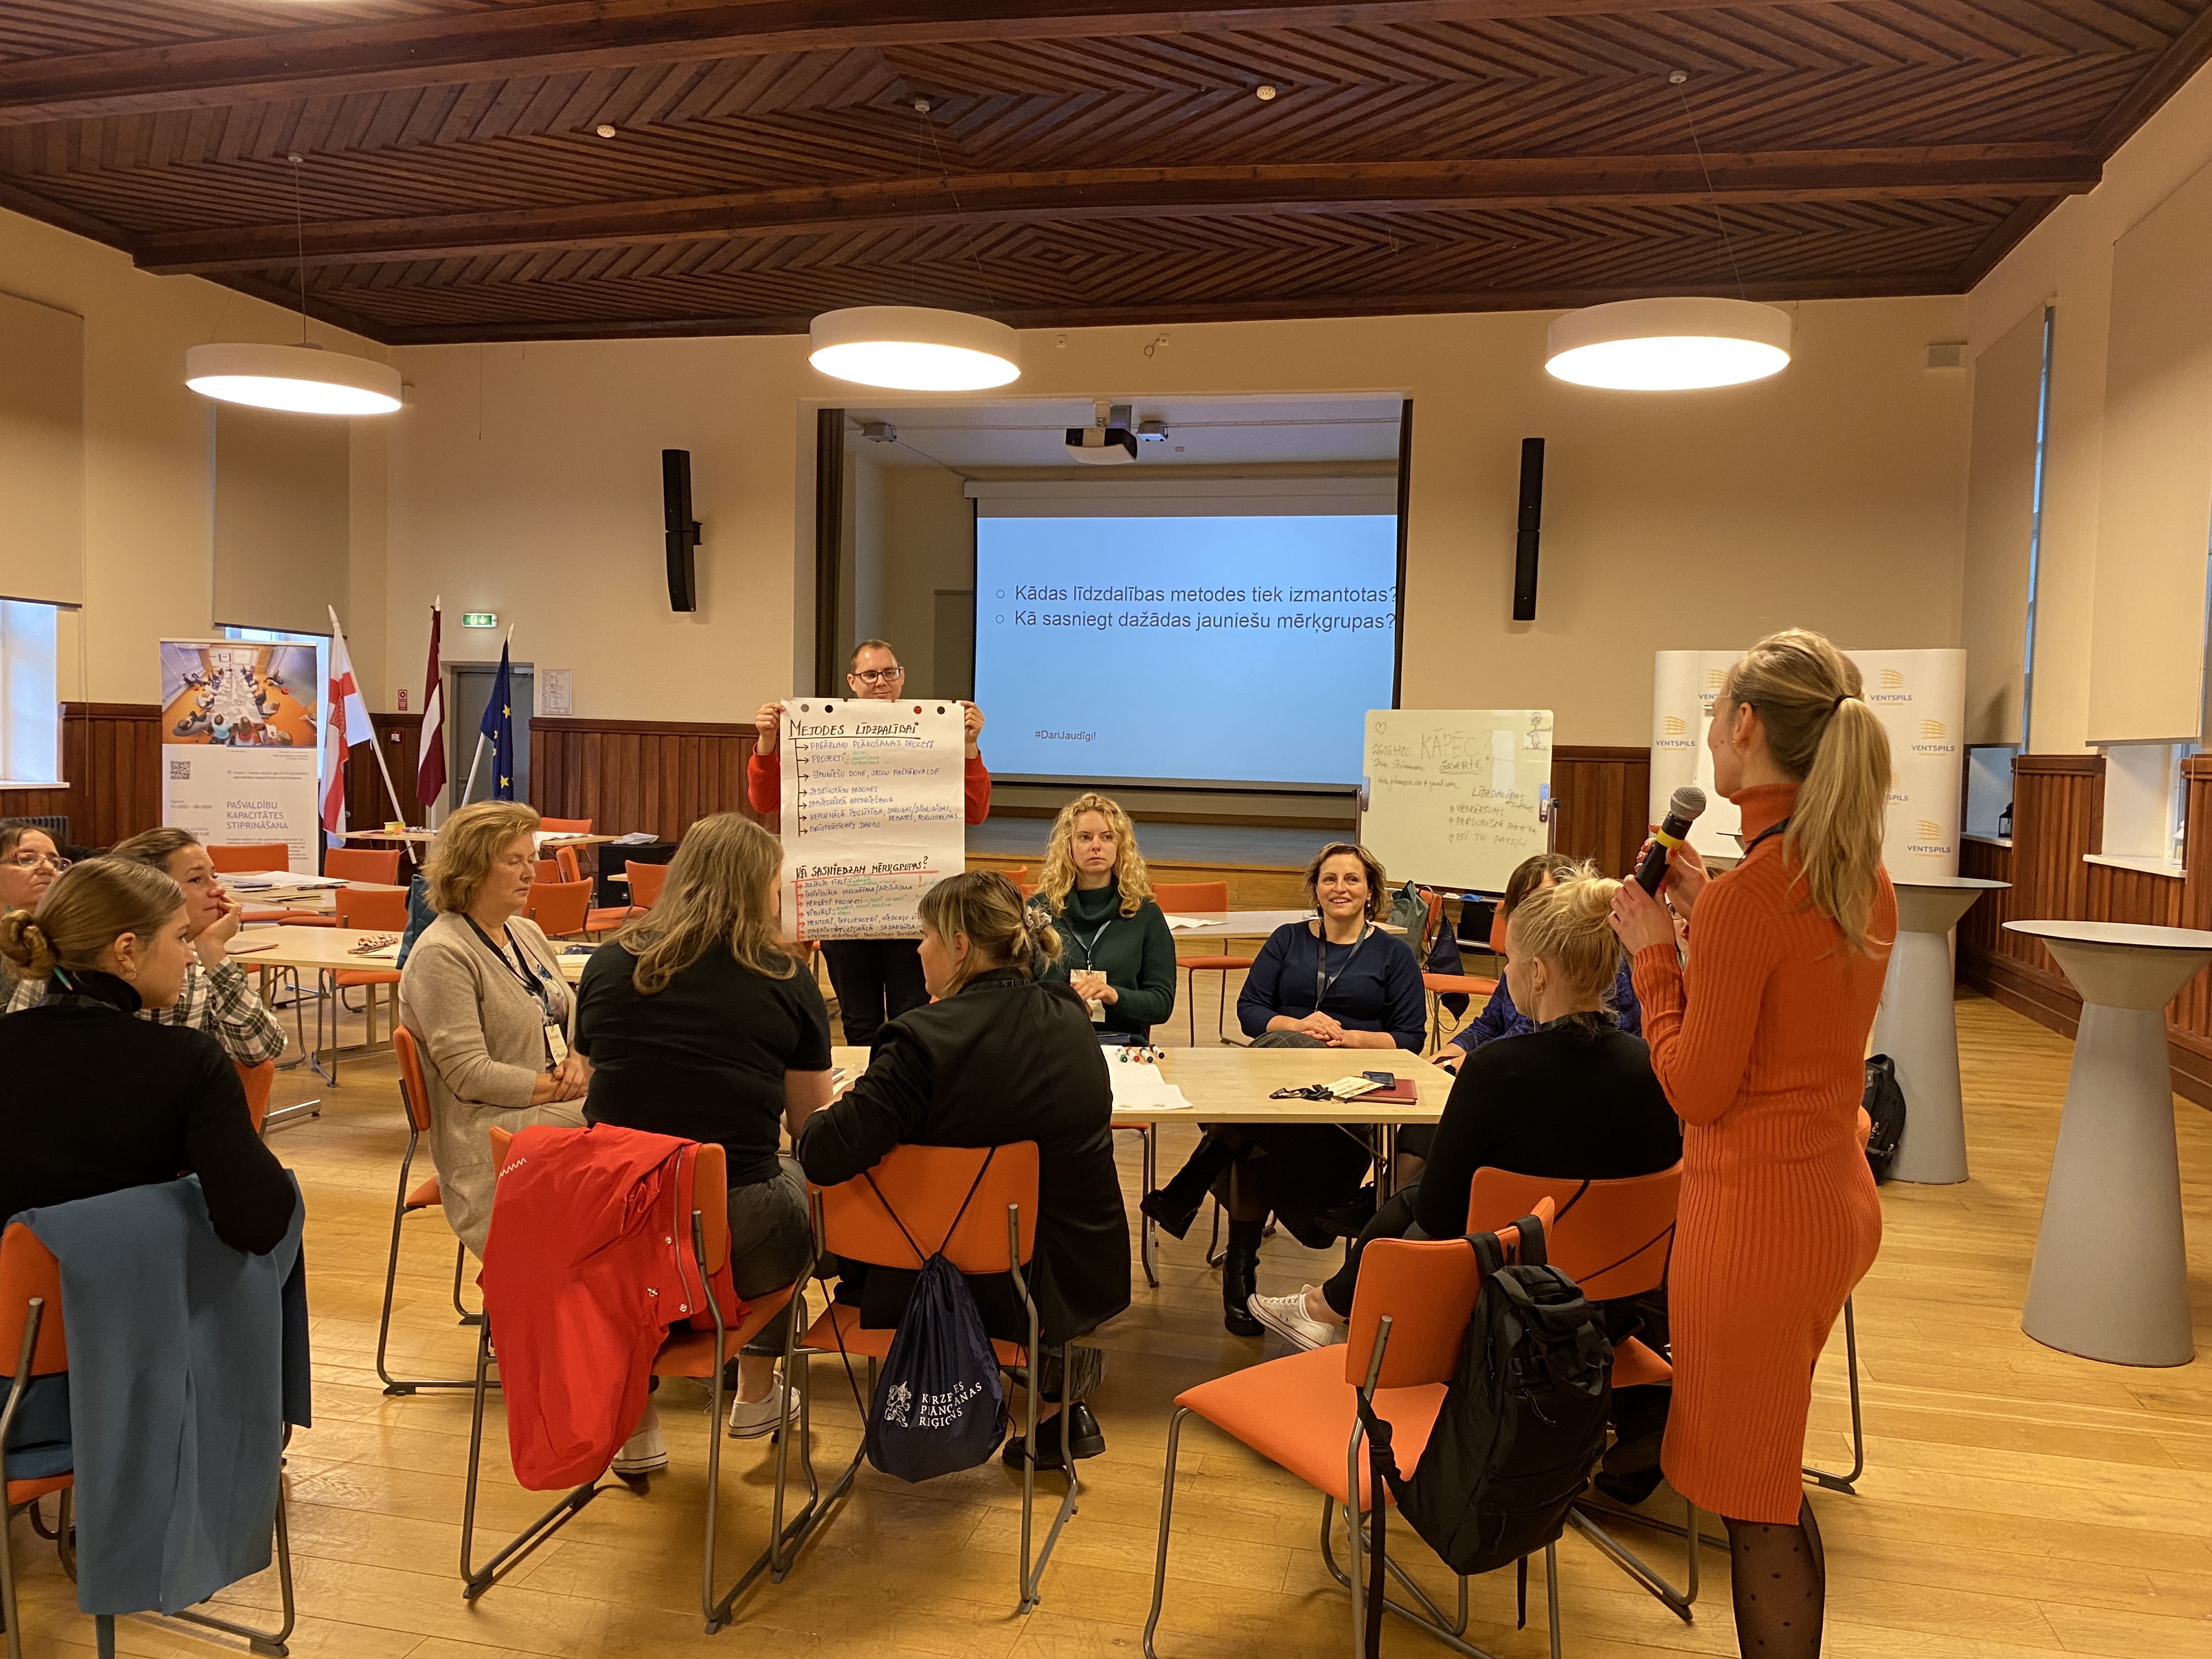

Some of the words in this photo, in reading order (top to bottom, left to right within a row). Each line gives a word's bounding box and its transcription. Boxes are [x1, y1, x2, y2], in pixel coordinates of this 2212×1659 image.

[1015, 585, 1067, 601] Kādas
[1074, 585, 1165, 602] līdzdalības
[1171, 587, 1245, 602] metodes
[1252, 586, 1283, 602] tiek
[1015, 611, 1036, 626] Kā
[1042, 612, 1113, 630] sasniegt
[1119, 611, 1190, 628] dažādas
[1196, 612, 1271, 631] jauniešu
[1277, 613, 1396, 633] mērķgrupas?
[789, 719, 844, 737] METODES
[1035, 730, 1096, 742] #DariJaudīgi!
[227, 800, 277, 809] PAŠVALDĪBU
[227, 811, 284, 819] KAPACITĀTES
[227, 821, 288, 829] STIPRINĀŠANA
[796, 865, 807, 880] KĀ
